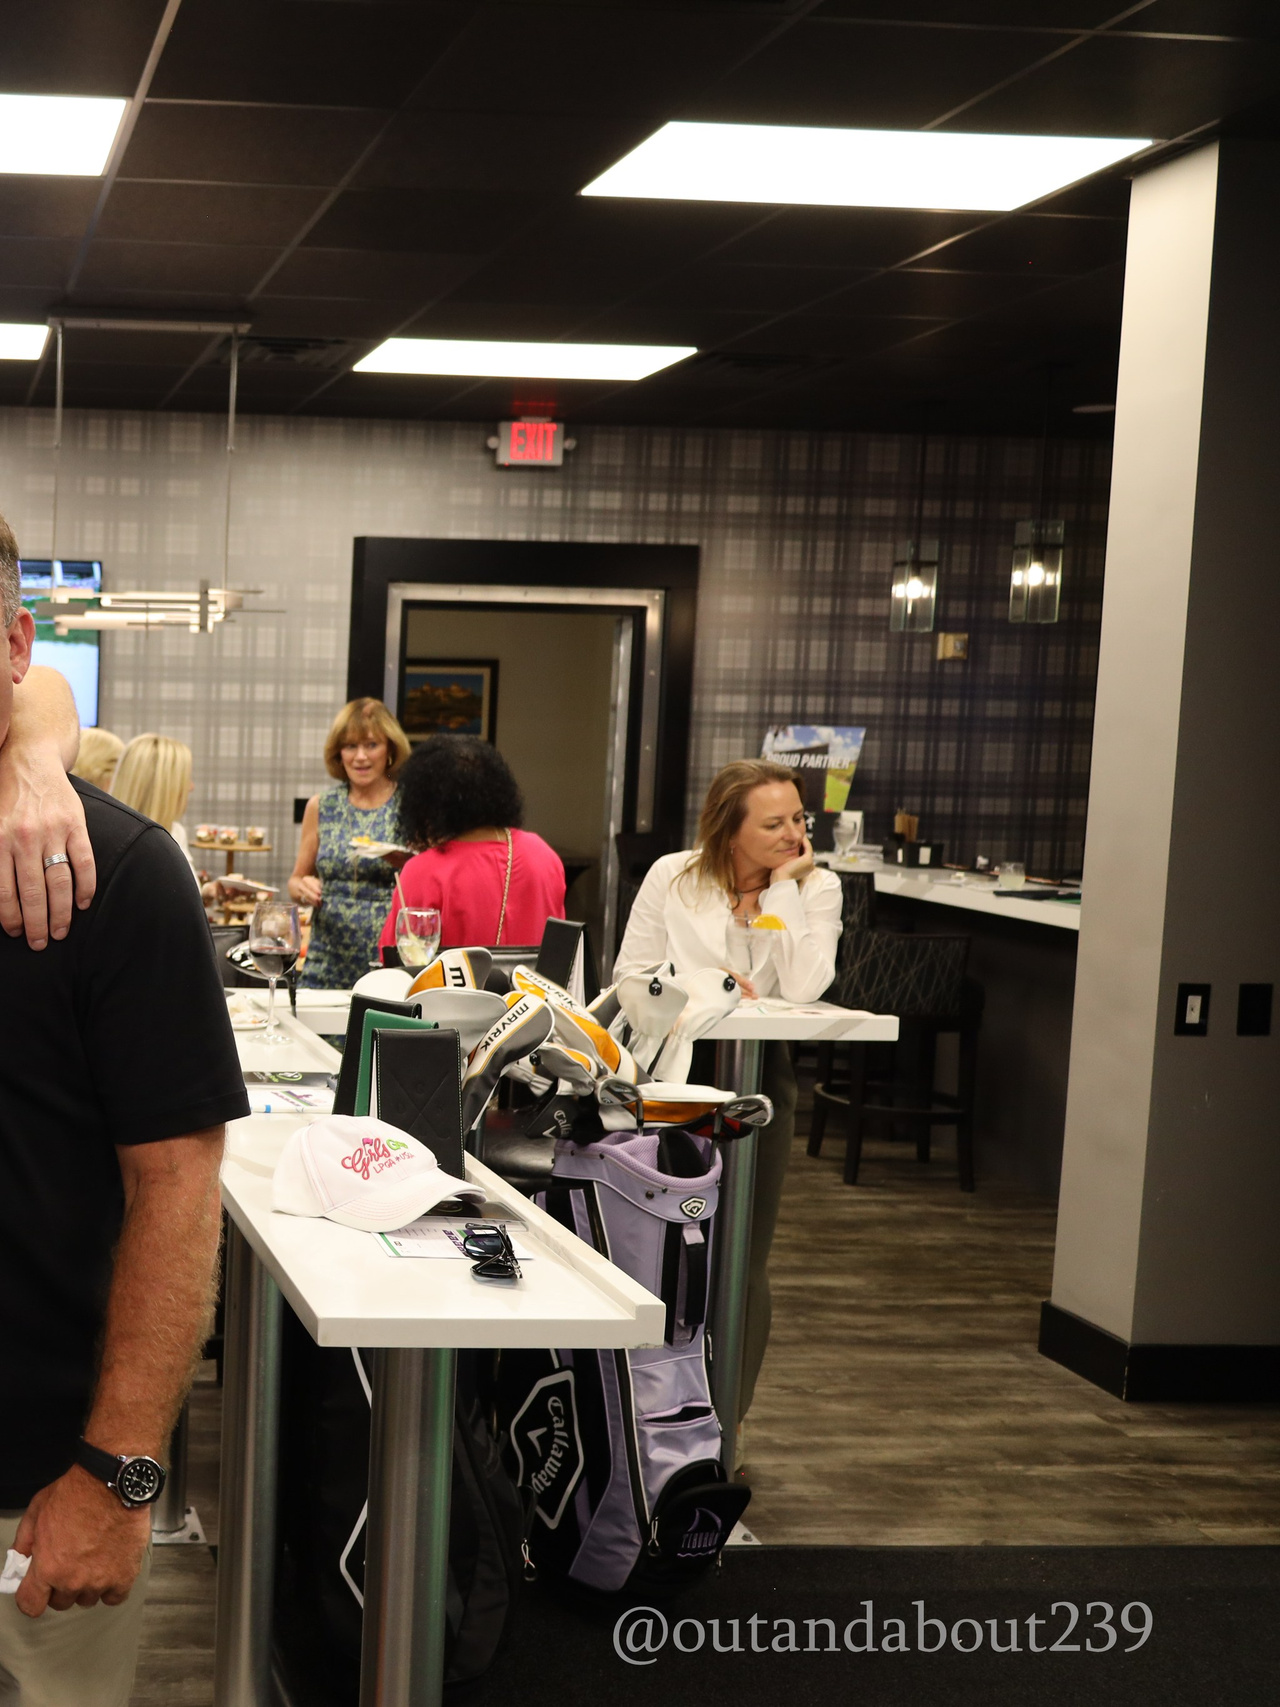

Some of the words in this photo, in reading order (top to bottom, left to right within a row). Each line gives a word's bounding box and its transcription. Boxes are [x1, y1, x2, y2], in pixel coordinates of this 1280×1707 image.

[510, 422, 557, 461] EXIT
[800, 753, 850, 769] PARTNER
[525, 972, 578, 1008] MAVRIK
[480, 1003, 530, 1052] MAVRIK
[341, 1137, 391, 1180] Girls
[531, 1395, 570, 1494] Callaway
